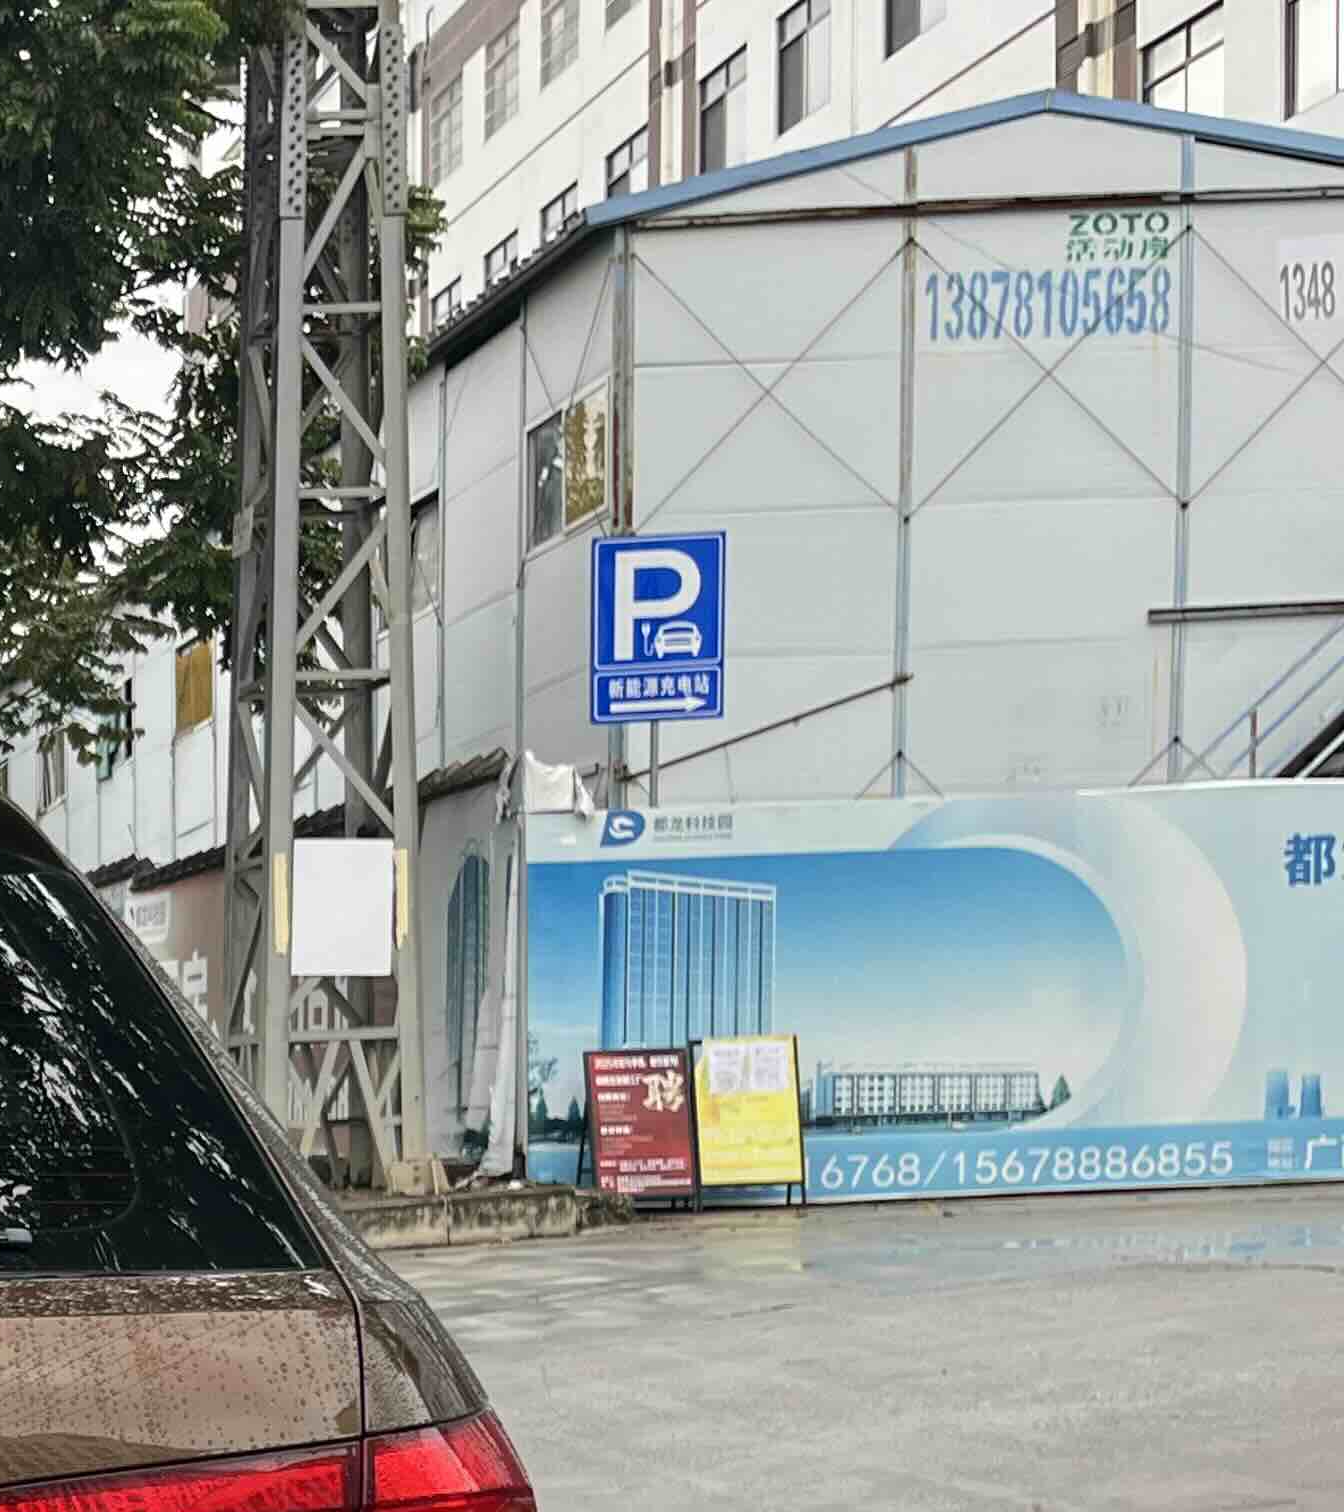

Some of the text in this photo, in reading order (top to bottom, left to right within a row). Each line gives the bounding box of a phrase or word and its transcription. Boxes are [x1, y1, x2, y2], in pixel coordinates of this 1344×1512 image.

[1069, 212, 1170, 236] ZOTO
[925, 267, 1171, 340] 13878105658
[1279, 261, 1336, 321] 1348
[614, 549, 701, 662] P
[608, 672, 711, 700] 新能源充电站
[1283, 833, 1344, 887] 都
